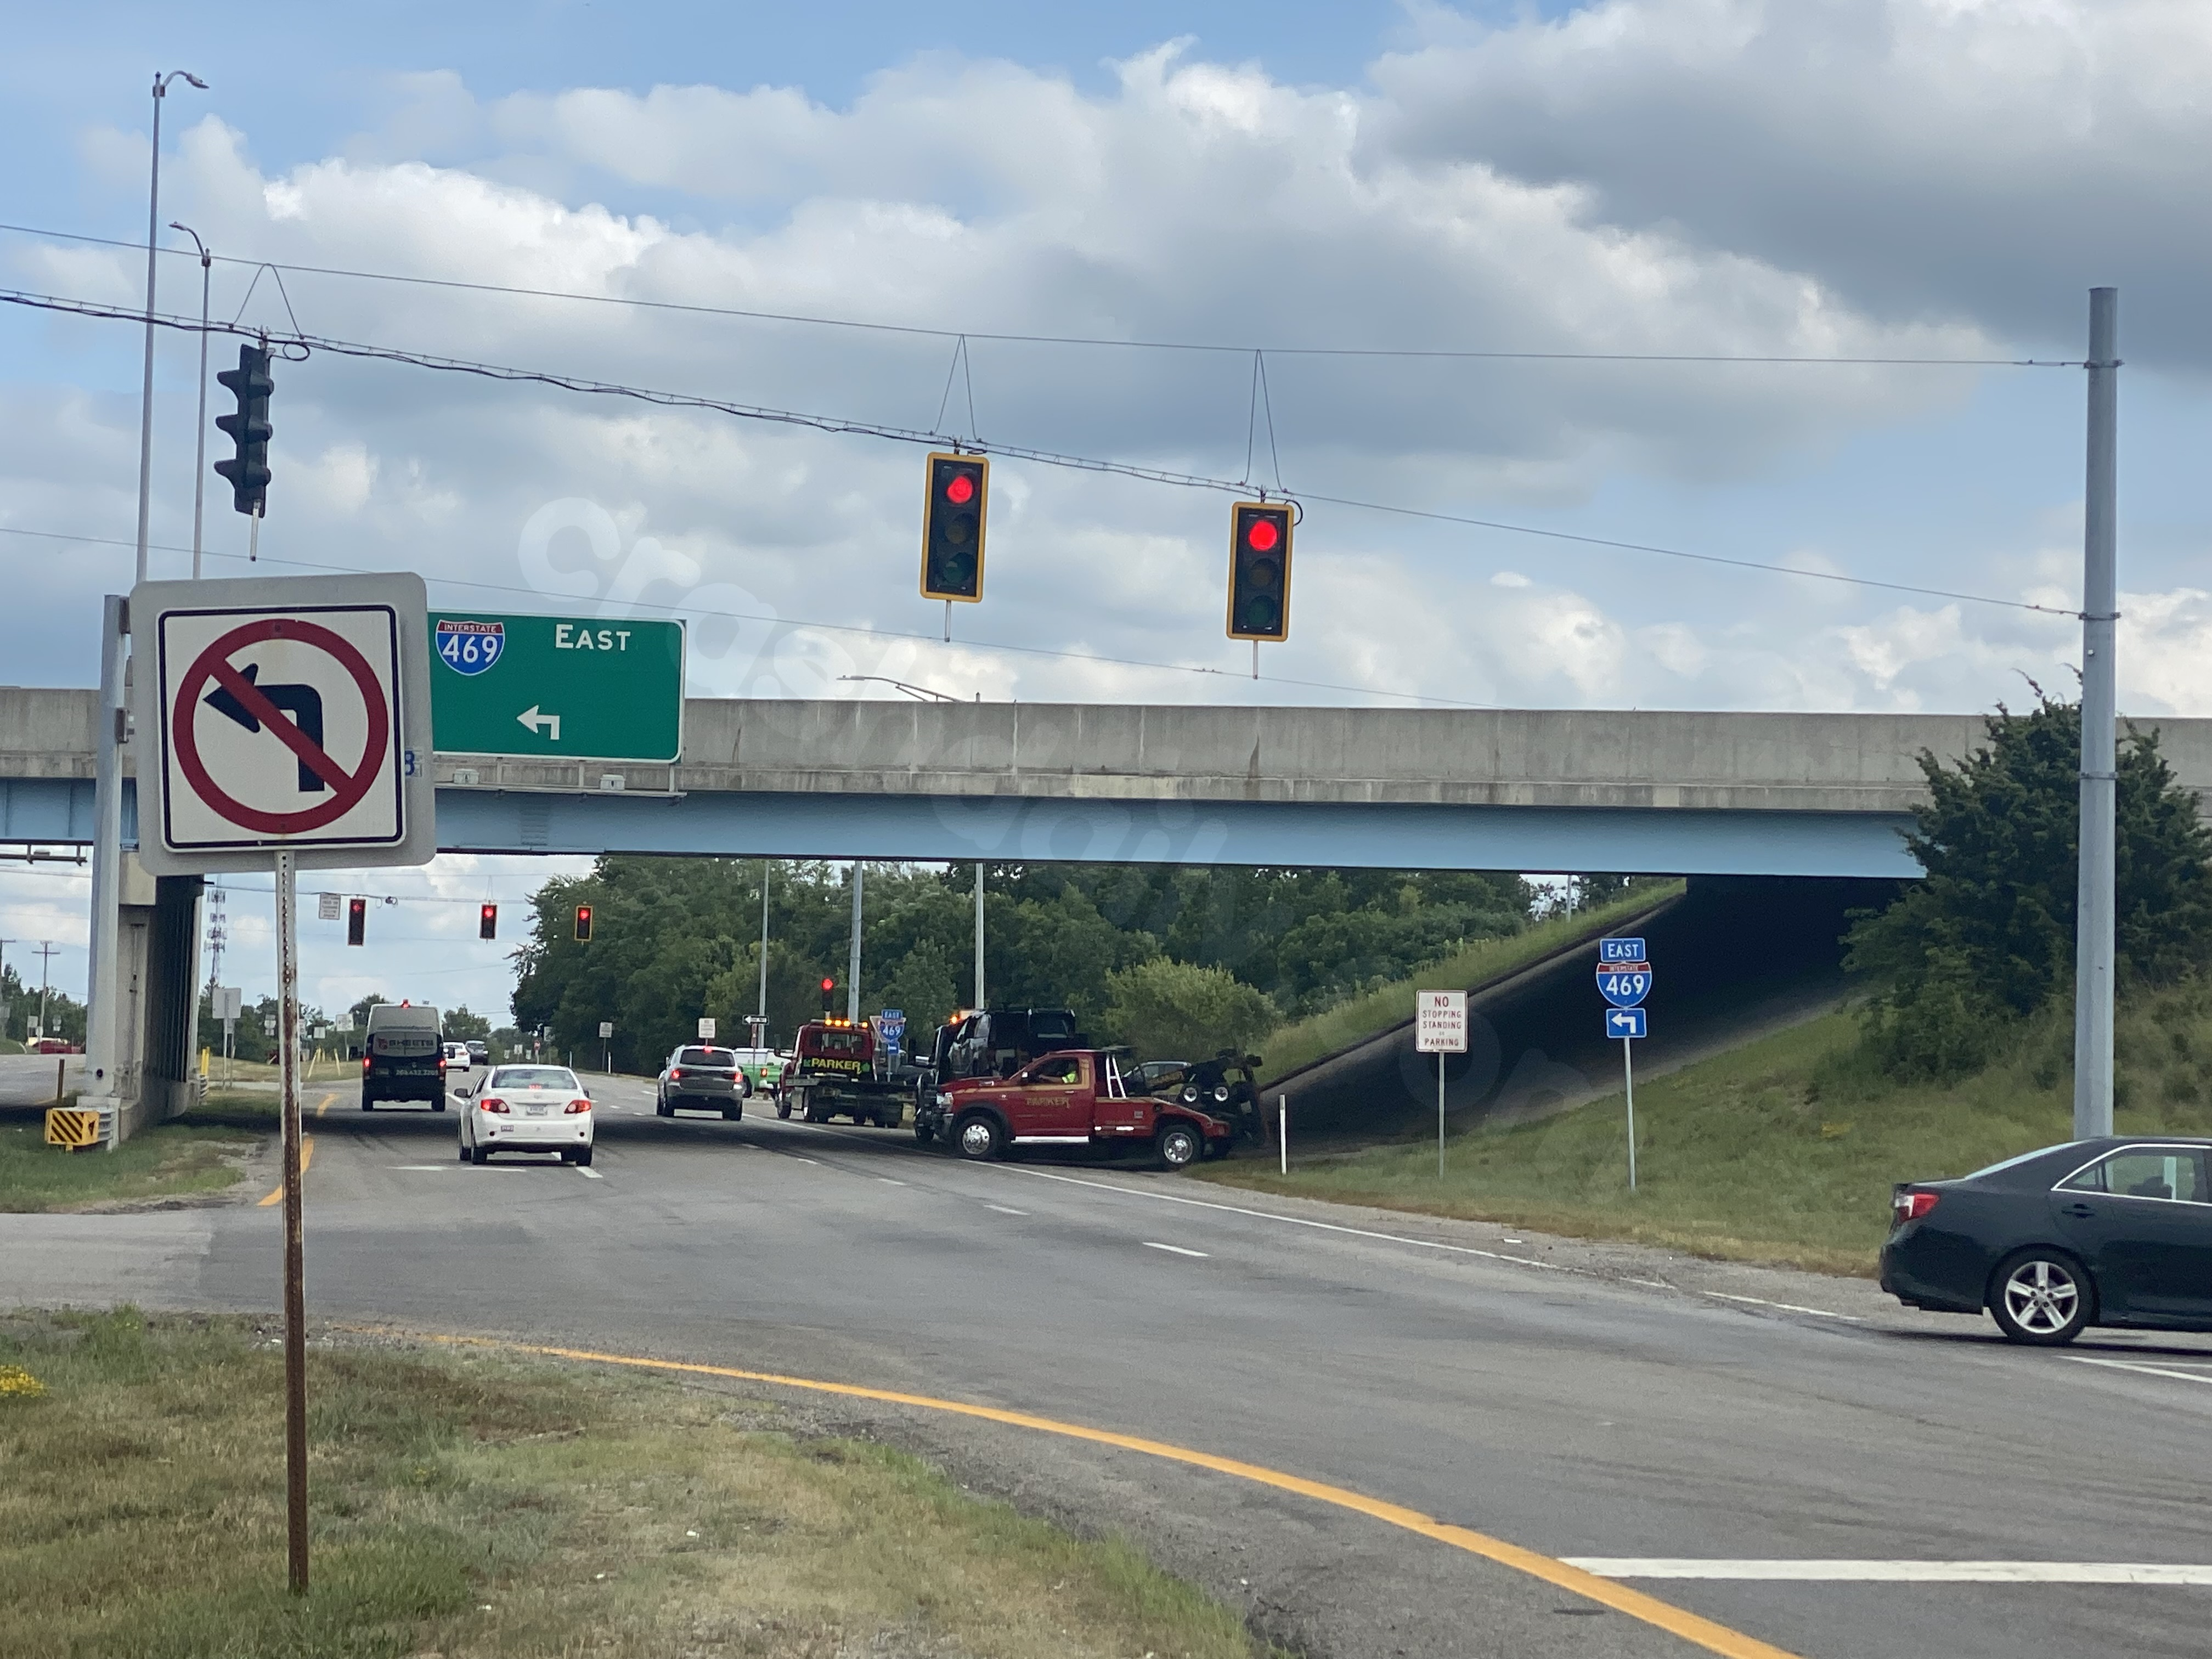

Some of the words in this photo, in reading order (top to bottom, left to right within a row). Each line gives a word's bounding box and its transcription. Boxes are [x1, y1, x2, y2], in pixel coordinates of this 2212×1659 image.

[444, 624, 496, 633] INTERSTATE
[442, 634, 498, 663] 469
[1608, 944, 1638, 957] EAST
[1606, 974, 1644, 995] 469
[1434, 996, 1449, 1007] NO
[1423, 1010, 1462, 1018] STOPPING
[883, 1025, 901, 1036] 469
[1423, 1021, 1462, 1029] STANDING
[1425, 1038, 1459, 1046] PARKING
[811, 1058, 861, 1074] PARKER
